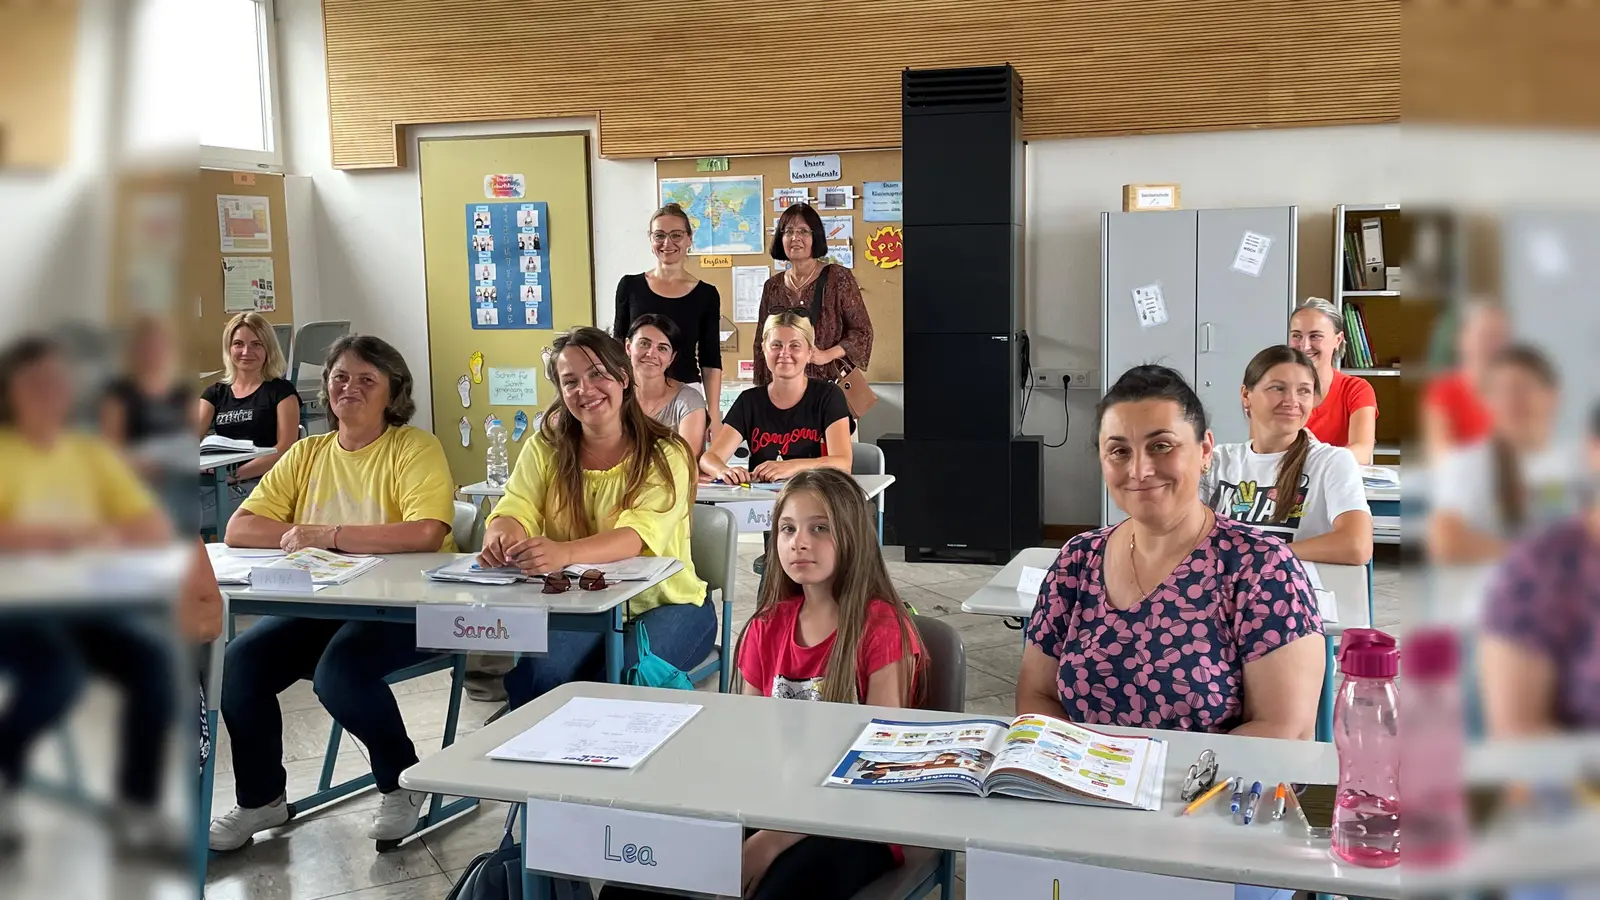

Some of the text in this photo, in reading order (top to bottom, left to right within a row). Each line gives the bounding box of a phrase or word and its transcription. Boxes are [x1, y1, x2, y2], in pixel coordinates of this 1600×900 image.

[703, 257, 729, 267] Englisch
[453, 615, 510, 641] Sarah
[960, 774, 980, 787] Was
[603, 825, 657, 867] Lea
